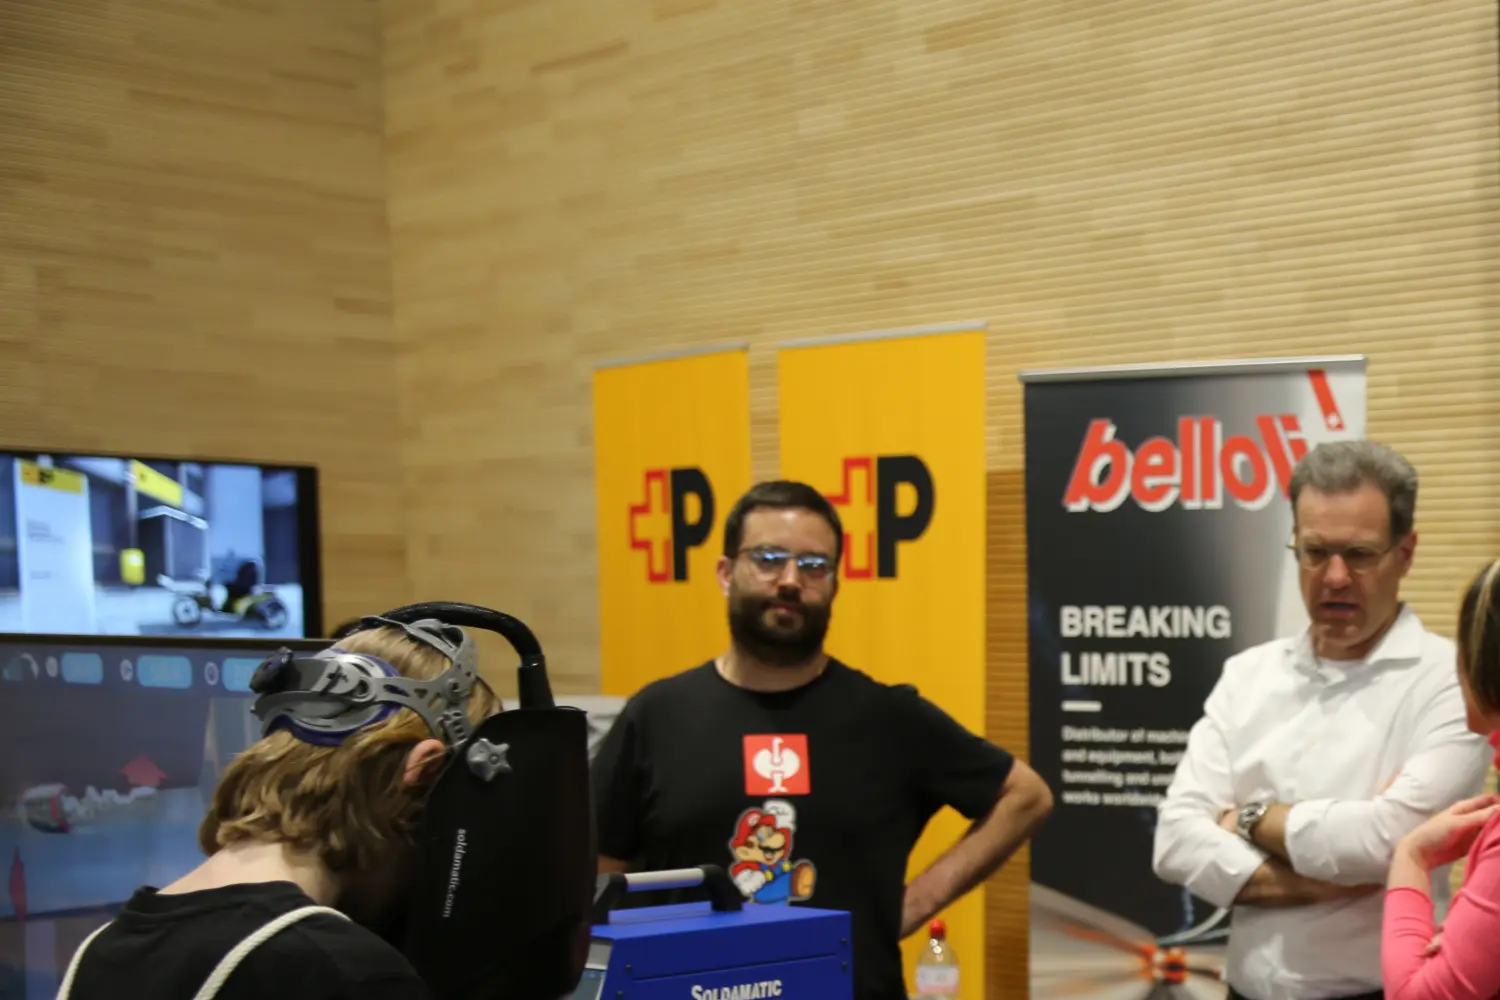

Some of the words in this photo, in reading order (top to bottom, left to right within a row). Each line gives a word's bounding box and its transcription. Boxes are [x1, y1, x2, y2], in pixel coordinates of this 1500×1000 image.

[1060, 604, 1232, 638] BREAKING
[1060, 651, 1172, 687] LIMITS
[1102, 791, 1167, 807] worldwid
[442, 828, 468, 918] soldamatic.com
